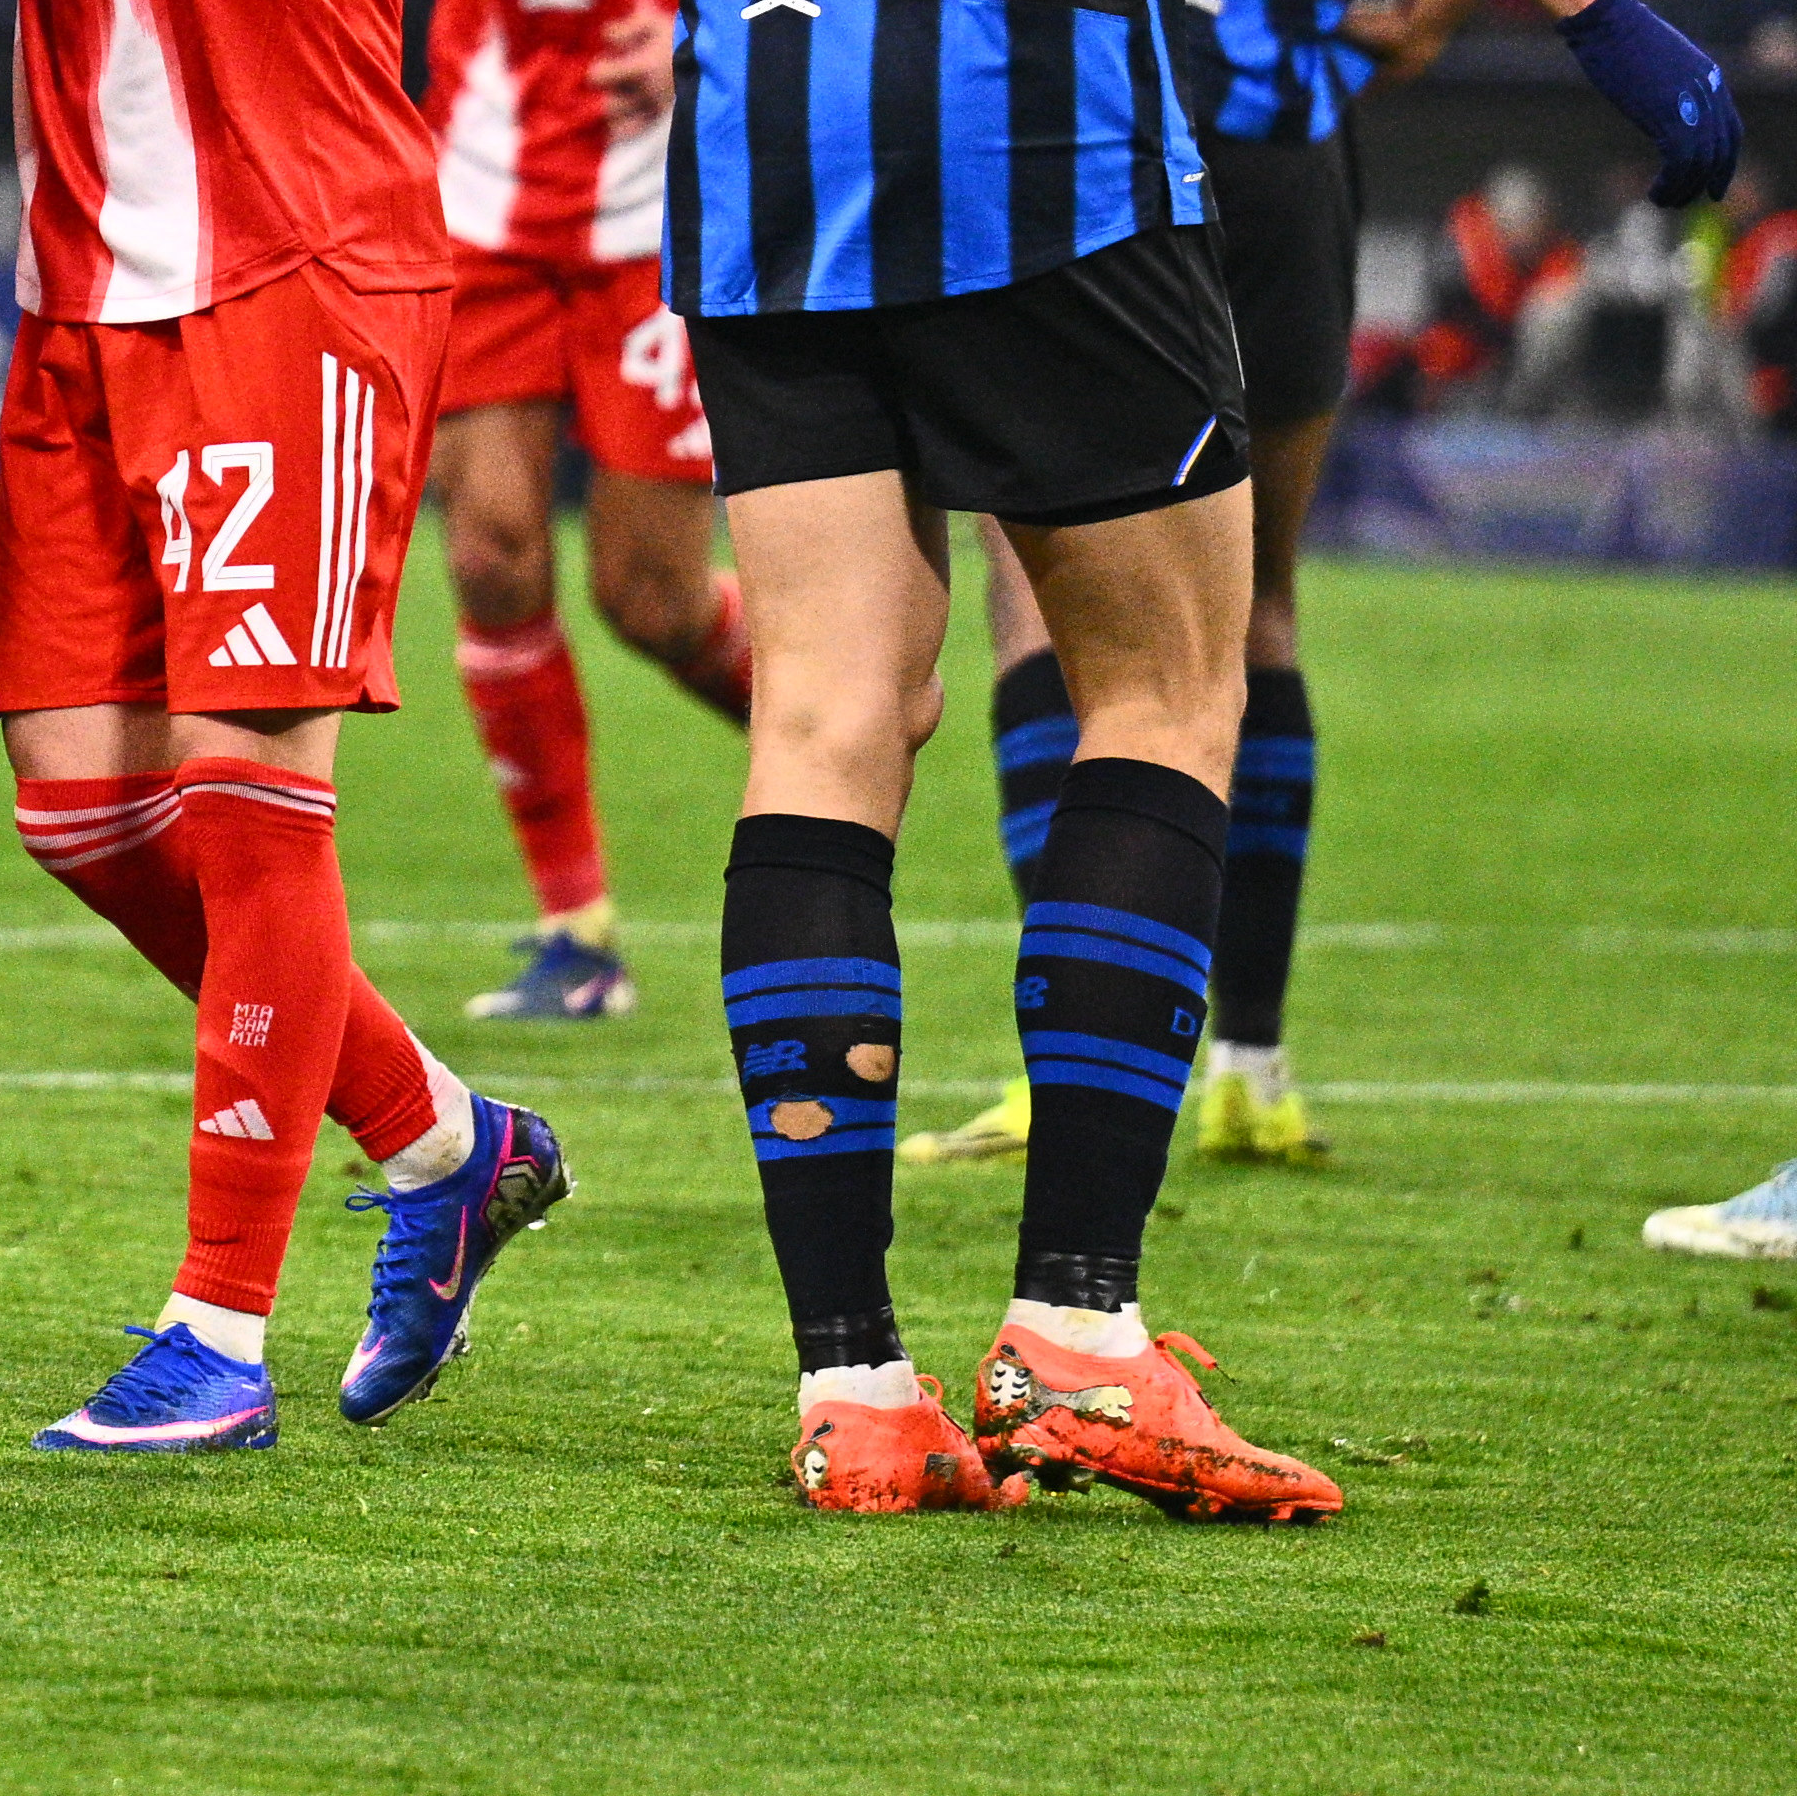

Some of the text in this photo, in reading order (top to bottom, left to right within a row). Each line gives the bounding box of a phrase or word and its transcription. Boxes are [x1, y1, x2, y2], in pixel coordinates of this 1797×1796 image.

[156, 441, 275, 594] 42
[234, 1002, 274, 1019] MIA
[232, 1016, 270, 1033] SAN
[229, 1030, 267, 1047] MIA
